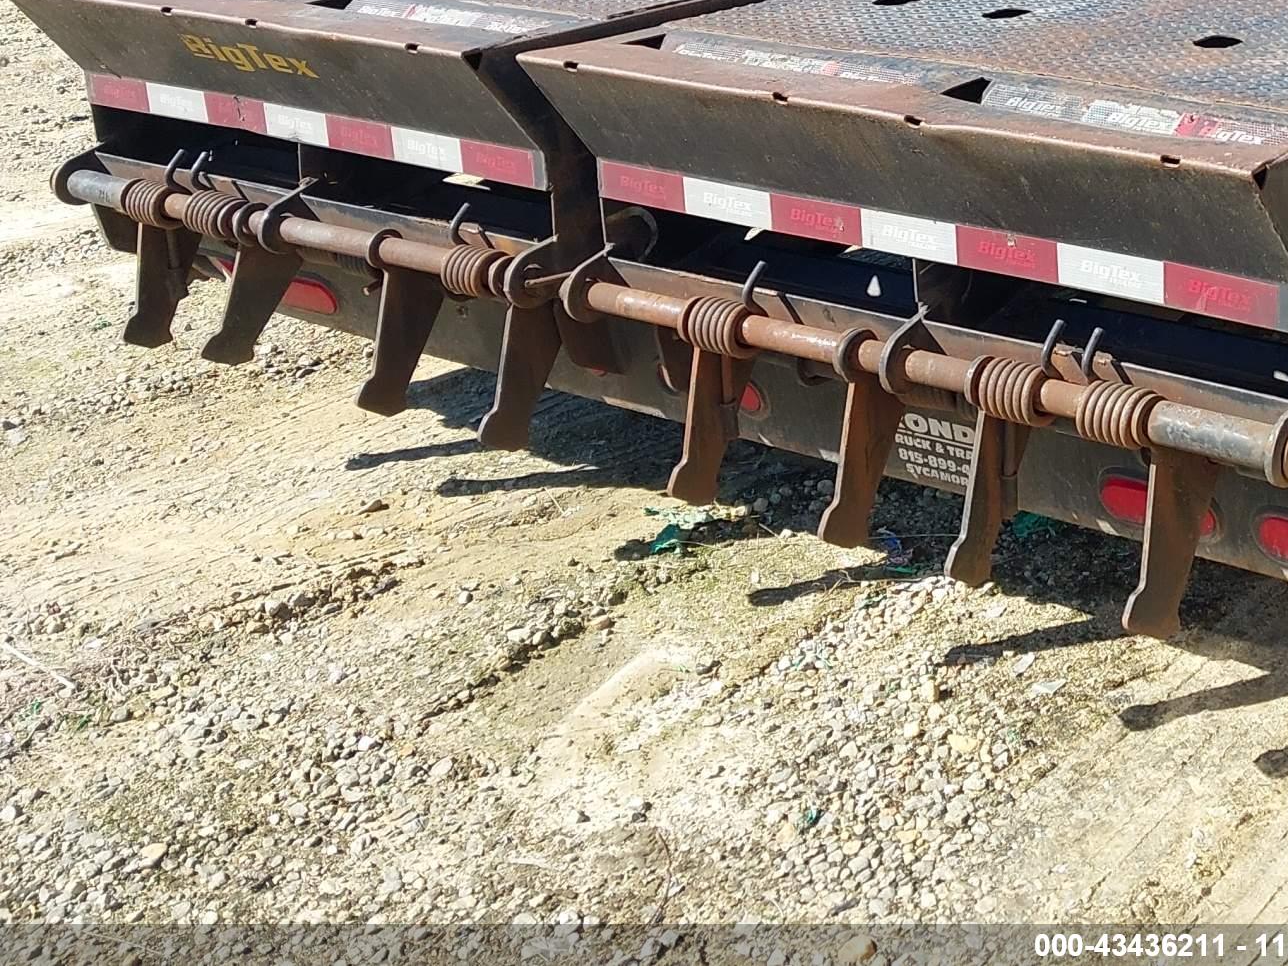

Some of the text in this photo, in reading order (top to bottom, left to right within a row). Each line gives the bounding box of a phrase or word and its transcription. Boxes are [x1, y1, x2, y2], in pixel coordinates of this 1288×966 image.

[178, 33, 320, 79] BigTex
[703, 191, 753, 211] BigTex
[882, 224, 938, 245] BigTex
[976, 240, 1036, 263] BigTex
[1080, 259, 1143, 282] BigTex
[898, 413, 976, 444] OND
